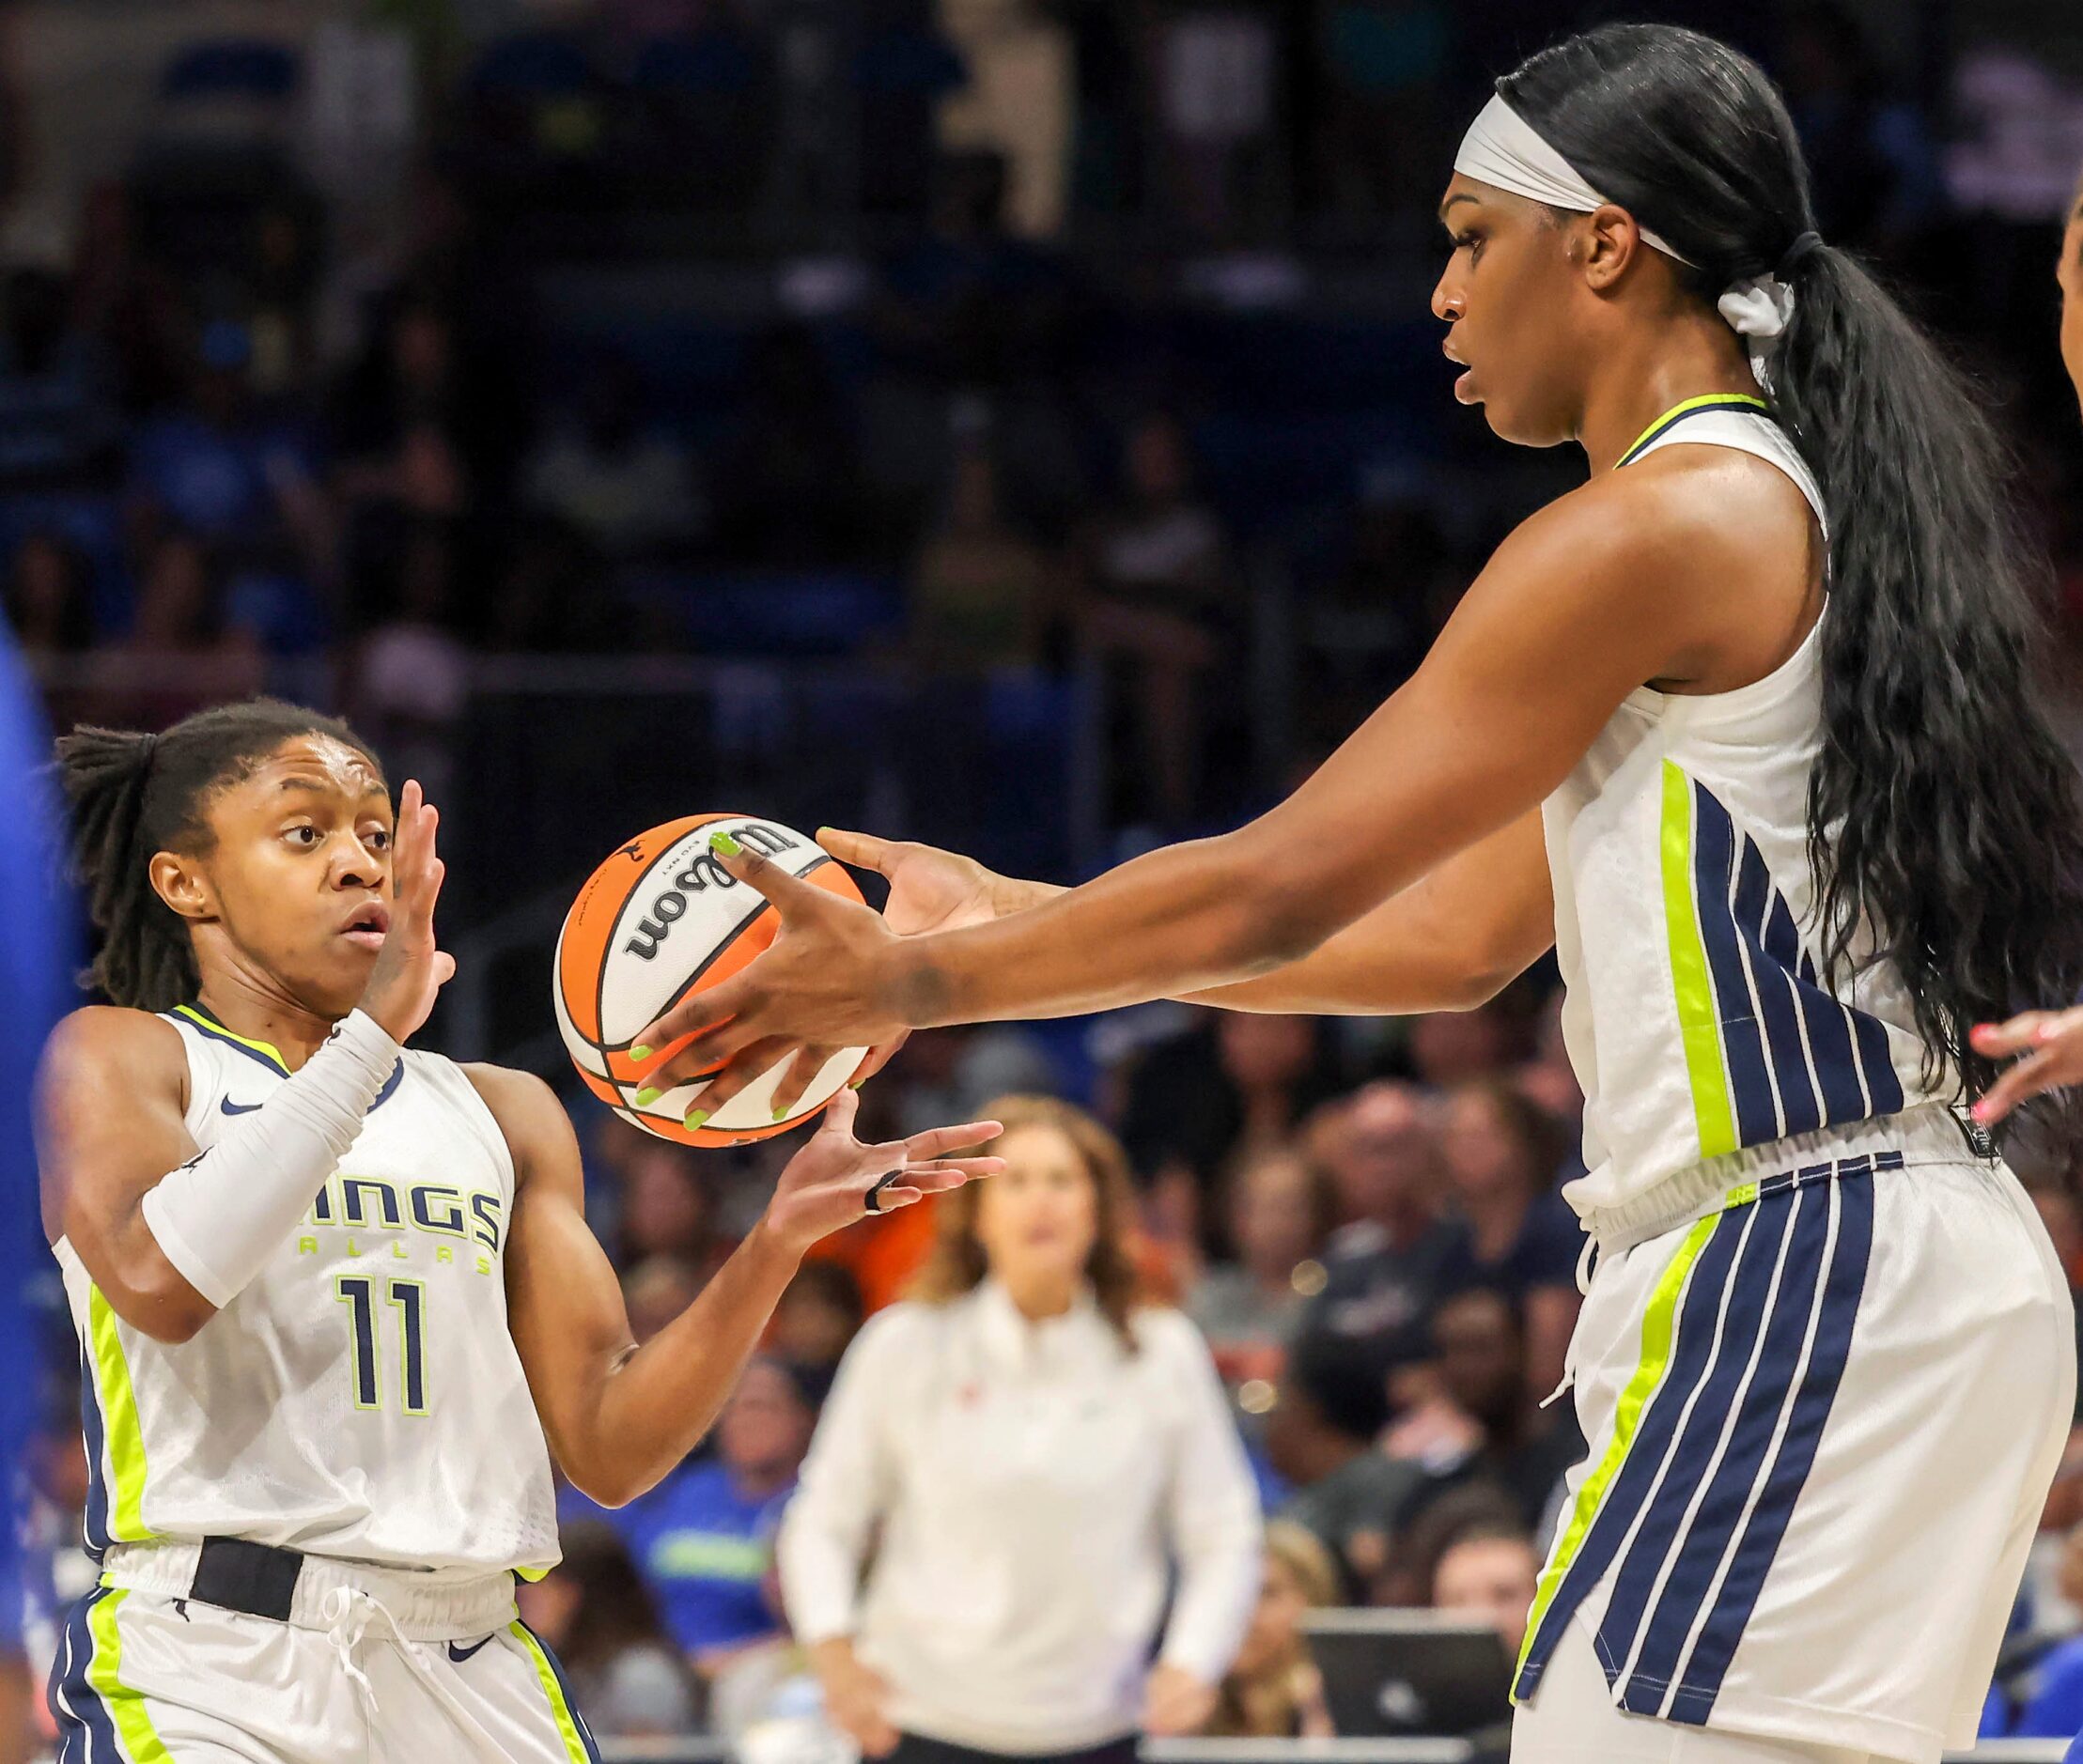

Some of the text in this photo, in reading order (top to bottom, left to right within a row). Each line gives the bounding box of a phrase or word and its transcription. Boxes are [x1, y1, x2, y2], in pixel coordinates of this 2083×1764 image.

[622, 824, 801, 963] Wlson
[661, 840, 701, 875] EVO NXT
[299, 1174, 503, 1260] INGS
[300, 1235, 491, 1277] ALLAS
[334, 1274, 430, 1416] 11
